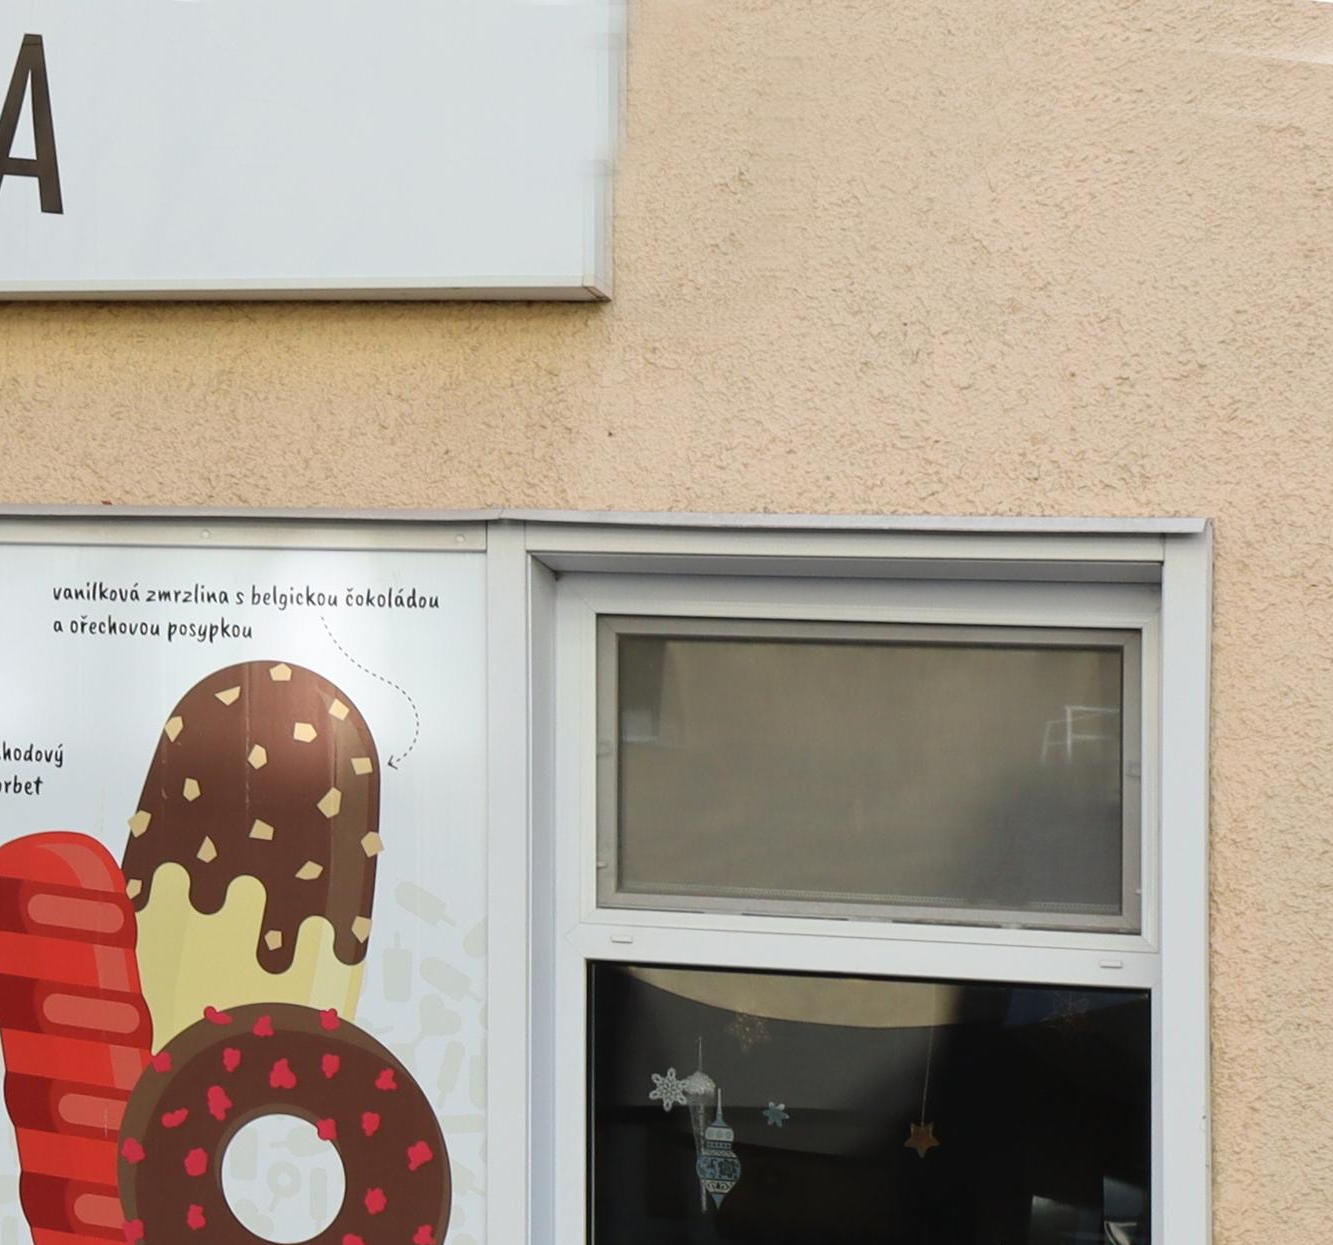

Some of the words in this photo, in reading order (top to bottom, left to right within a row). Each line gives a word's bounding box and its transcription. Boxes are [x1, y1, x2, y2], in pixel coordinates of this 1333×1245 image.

[53, 581, 140, 602] vanilková
[145, 583, 229, 604] zmrzlina
[236, 591, 245, 605] s
[251, 584, 338, 611] belgickou
[345, 587, 439, 609] čokoládou
[53, 620, 64, 633] a
[70, 614, 160, 636] ořechovou
[167, 617, 252, 644] posypkou
